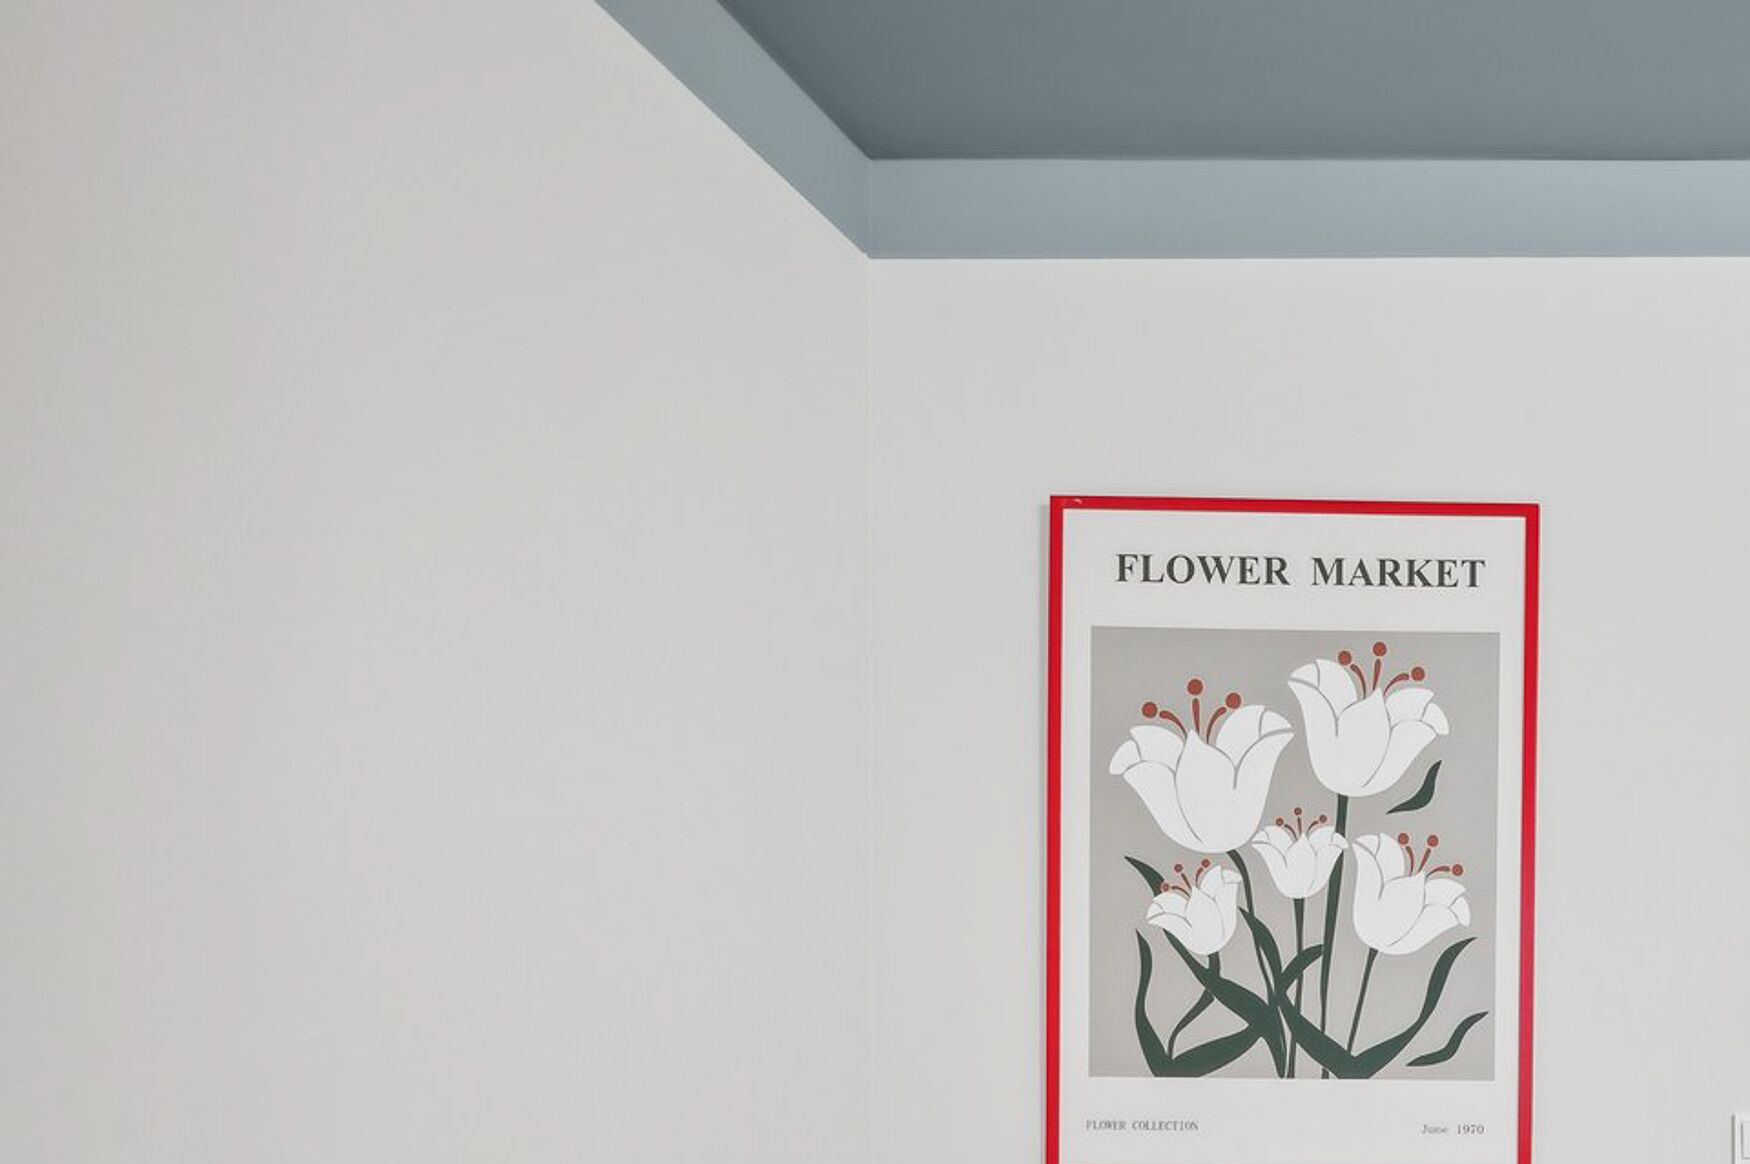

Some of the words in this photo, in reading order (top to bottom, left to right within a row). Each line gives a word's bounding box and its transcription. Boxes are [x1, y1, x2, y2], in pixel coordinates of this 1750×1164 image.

[1115, 553, 1291, 586] FLOWER
[1311, 557, 1486, 588] MARKET
[1085, 1119, 1127, 1132] FLOWER
[1131, 1120, 1199, 1133] COLLECTION
[1457, 1123, 1485, 1135] 1970
